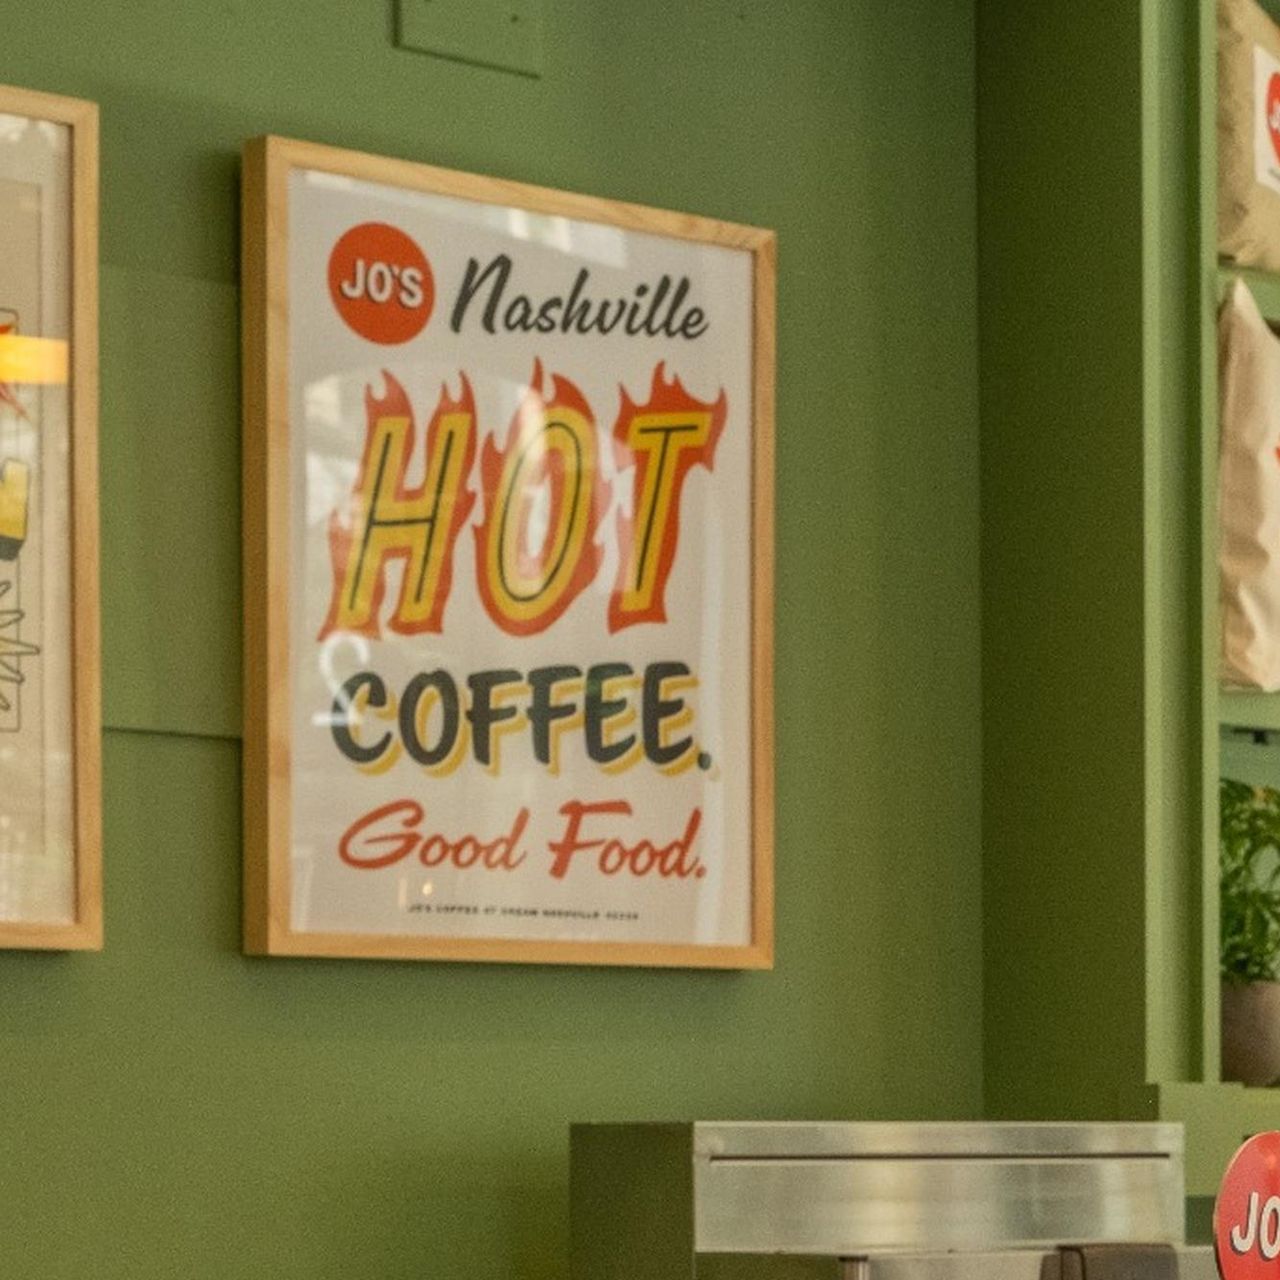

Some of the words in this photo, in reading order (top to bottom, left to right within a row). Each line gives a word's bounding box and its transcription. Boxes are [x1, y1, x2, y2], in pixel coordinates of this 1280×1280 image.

[341, 259, 424, 309] JO'S
[450, 253, 710, 340] Nashville
[333, 403, 714, 630] HOT
[330, 661, 717, 778] COFFEE.
[338, 799, 529, 870] Good
[547, 800, 708, 880] Food.
